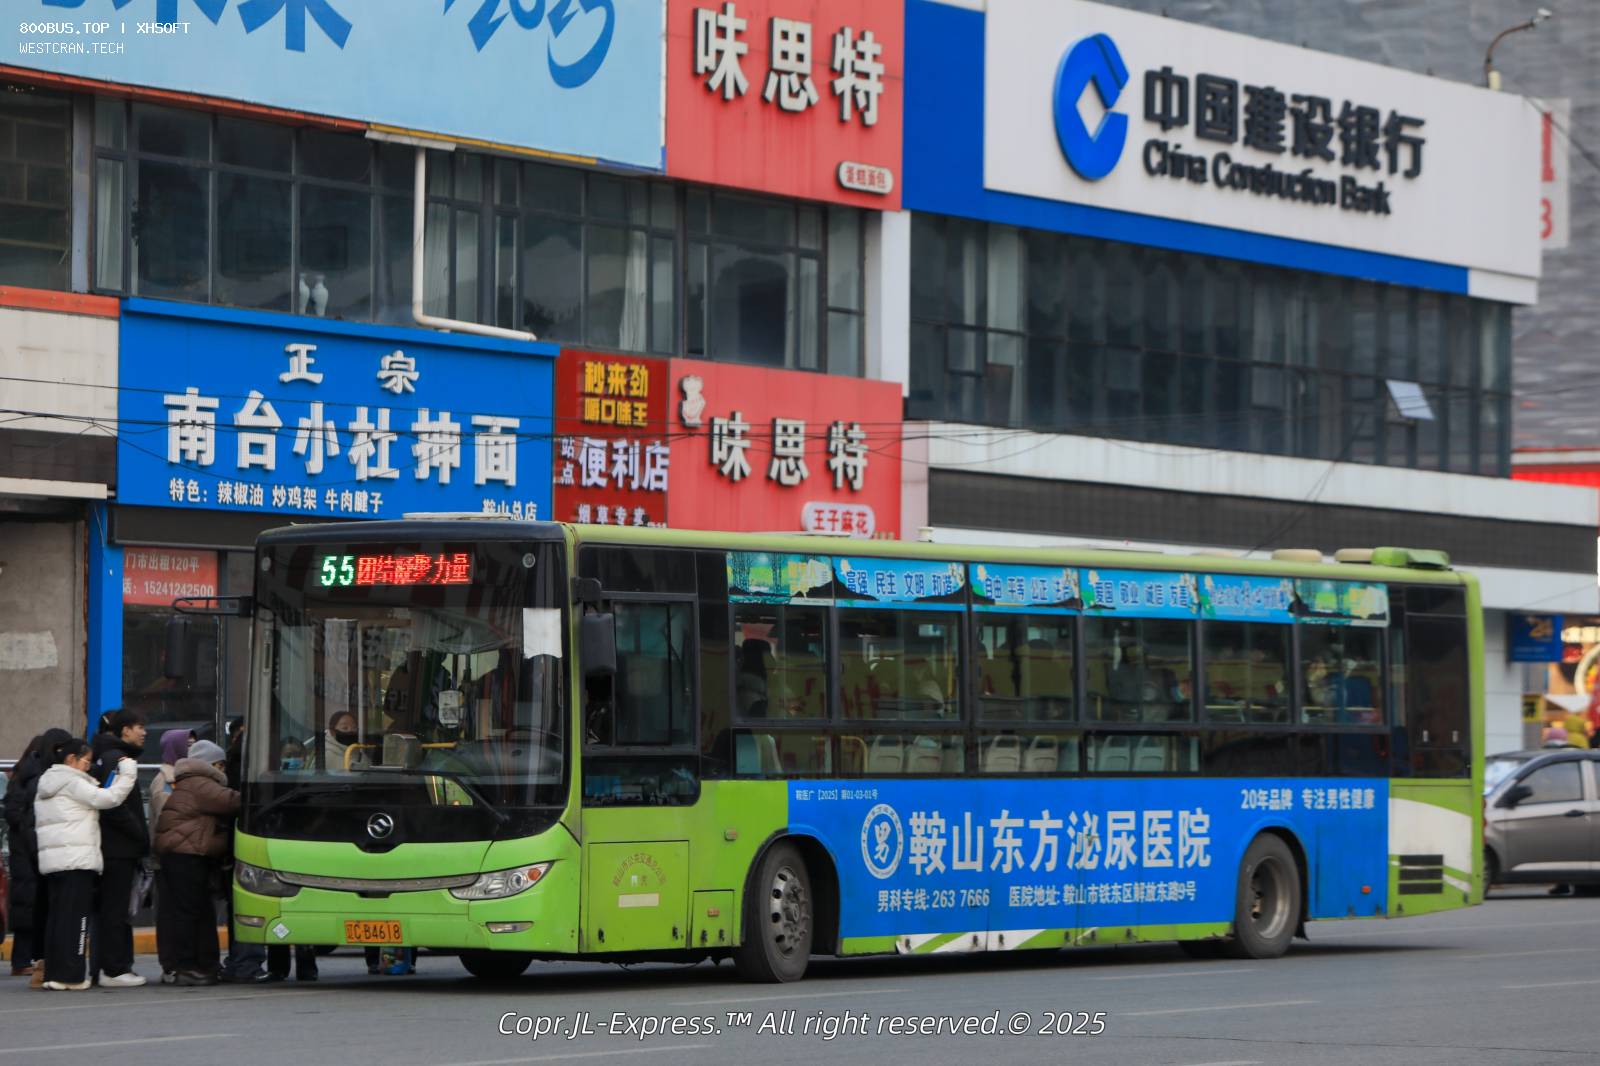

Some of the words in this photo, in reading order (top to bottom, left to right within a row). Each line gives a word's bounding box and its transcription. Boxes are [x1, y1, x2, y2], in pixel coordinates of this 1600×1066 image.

[692, 2, 886, 126] 味思特
[1144, 65, 1426, 179] 中国建设银行
[1143, 139, 1208, 183] China
[1212, 151, 1336, 205] Construction
[1340, 175, 1392, 215] Bank
[279, 343, 419, 394] 正宗
[163, 387, 520, 487] 南台小杜抻面
[708, 410, 868, 490] 味思特
[578, 437, 670, 492] 便利店
[271, 485, 317, 510] 炒鸡架
[324, 488, 384, 514] 牛肉腱子
[482, 498, 538, 521] 鞍山总店
[813, 509, 868, 535] 王子麻花
[321, 555, 355, 586] 55
[846, 570, 869, 595] 富强
[874, 570, 897, 595] 民主
[903, 572, 925, 596] 文明
[932, 573, 953, 597] 和谐
[1241, 788, 1293, 810] 20年品牌
[1301, 788, 1375, 811] 专注男性健康
[908, 807, 1212, 876] 鞍山东方泌尿医院
[960, 888, 990, 908] 7666
